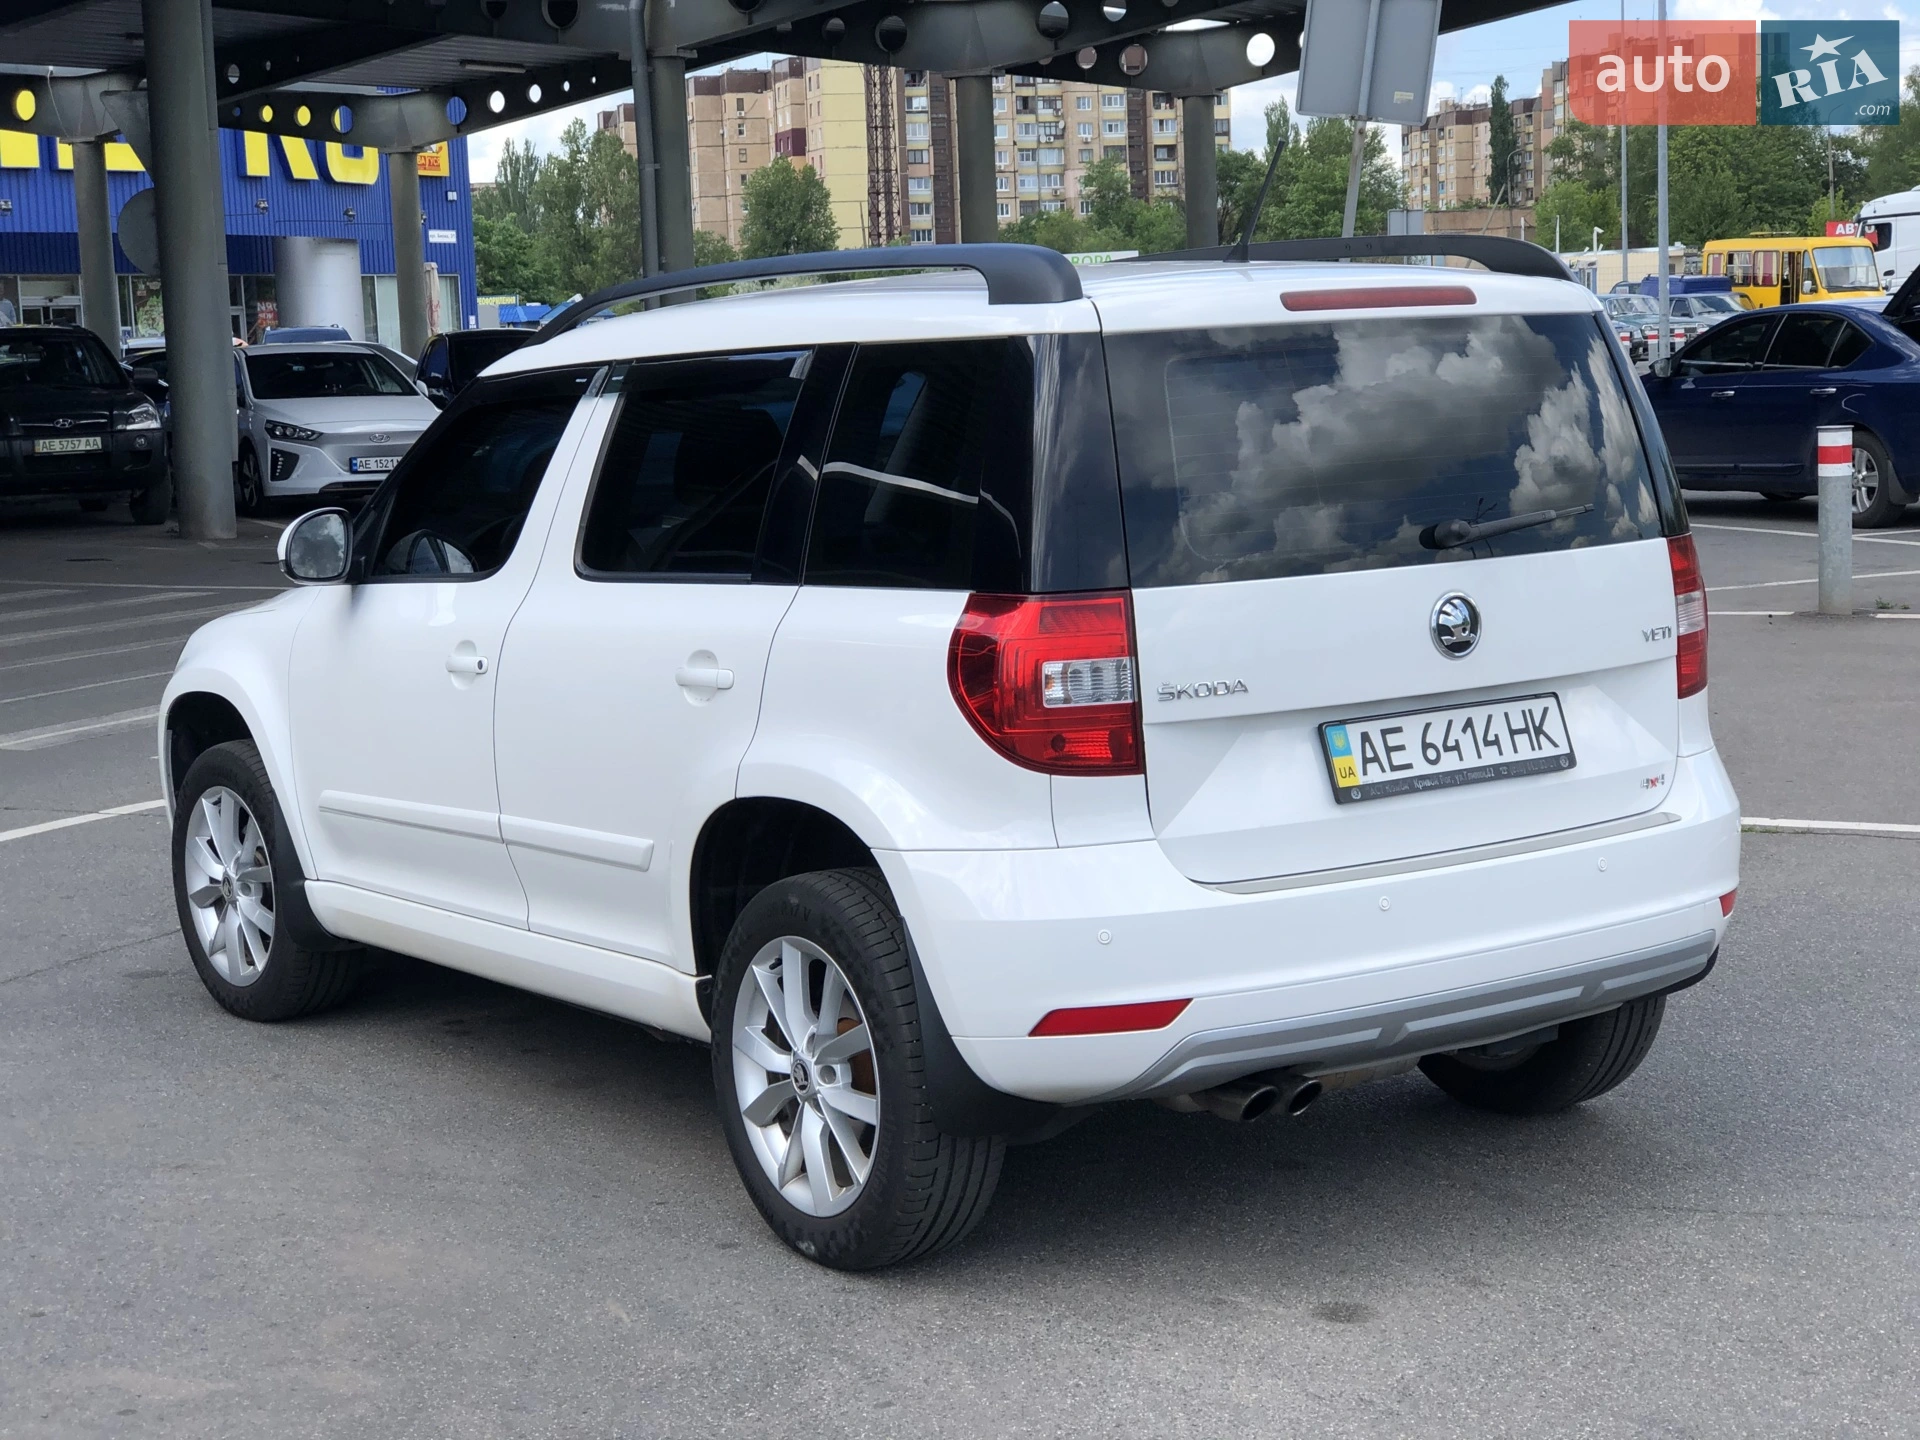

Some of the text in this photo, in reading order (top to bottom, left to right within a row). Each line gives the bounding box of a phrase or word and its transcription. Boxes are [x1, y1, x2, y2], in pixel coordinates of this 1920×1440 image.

[41, 439, 100, 451] AE 5757 AA
[358, 459, 371, 469] AE
[1641, 625, 1673, 642] YETI
[1157, 679, 1249, 701] ŠKODA
[1360, 706, 1560, 776] AE 6414 HK
[1338, 766, 1357, 779] UA
